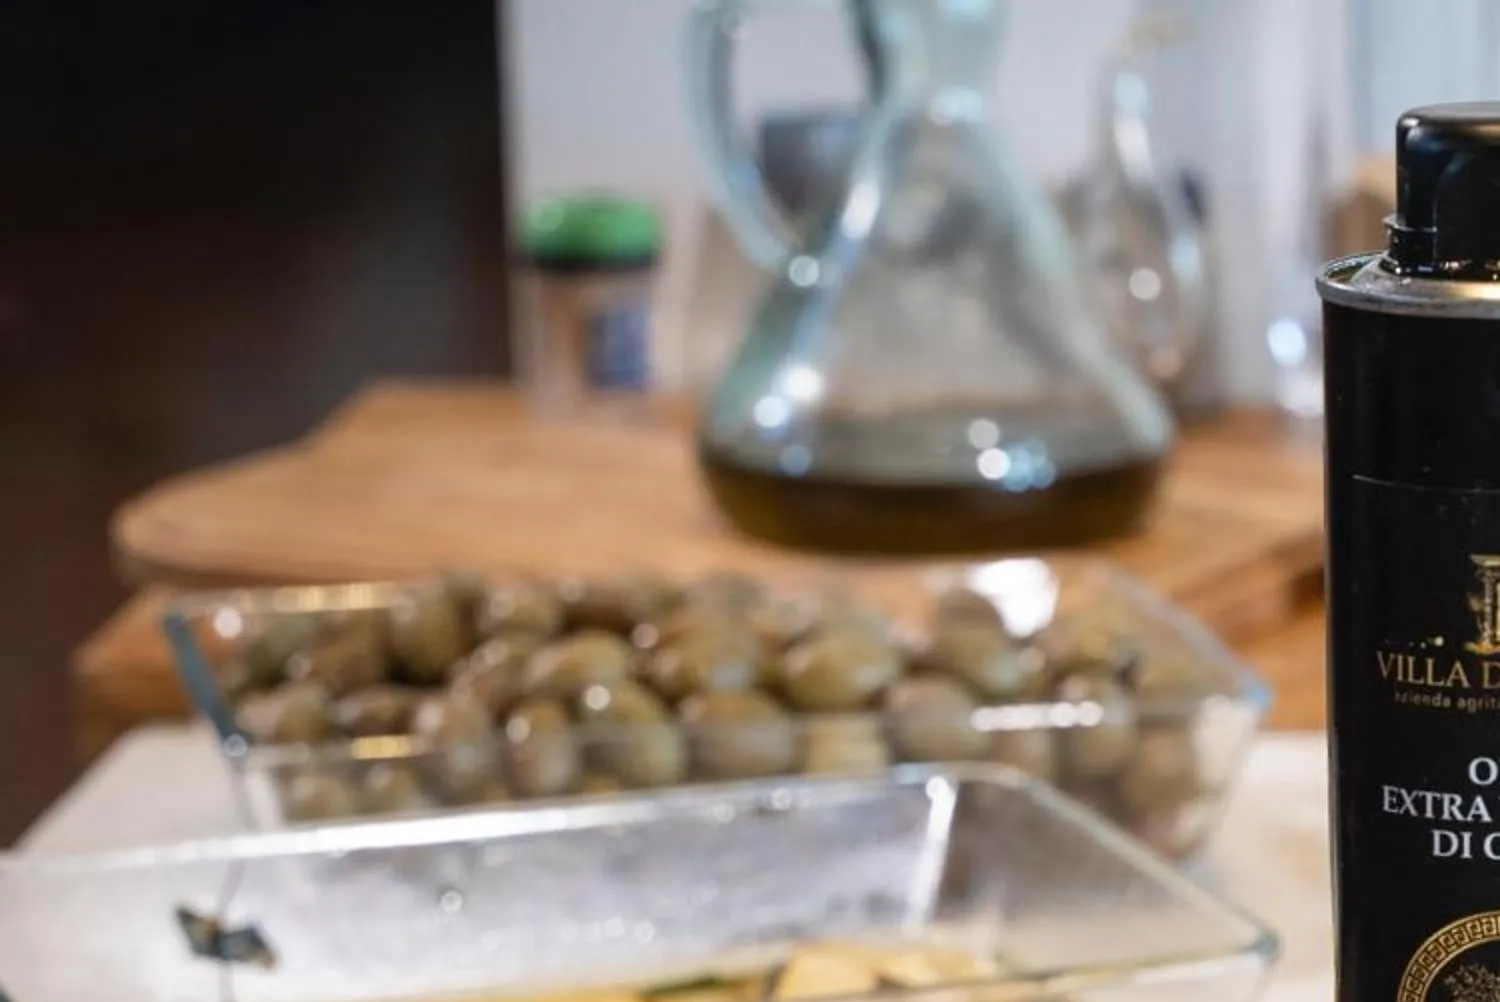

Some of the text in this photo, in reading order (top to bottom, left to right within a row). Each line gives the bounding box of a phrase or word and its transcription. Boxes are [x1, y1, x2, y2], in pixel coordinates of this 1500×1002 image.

[1376, 651, 1469, 689] VILLA
[1382, 785, 1492, 822] EXTRA
[1432, 830, 1473, 859] DI
